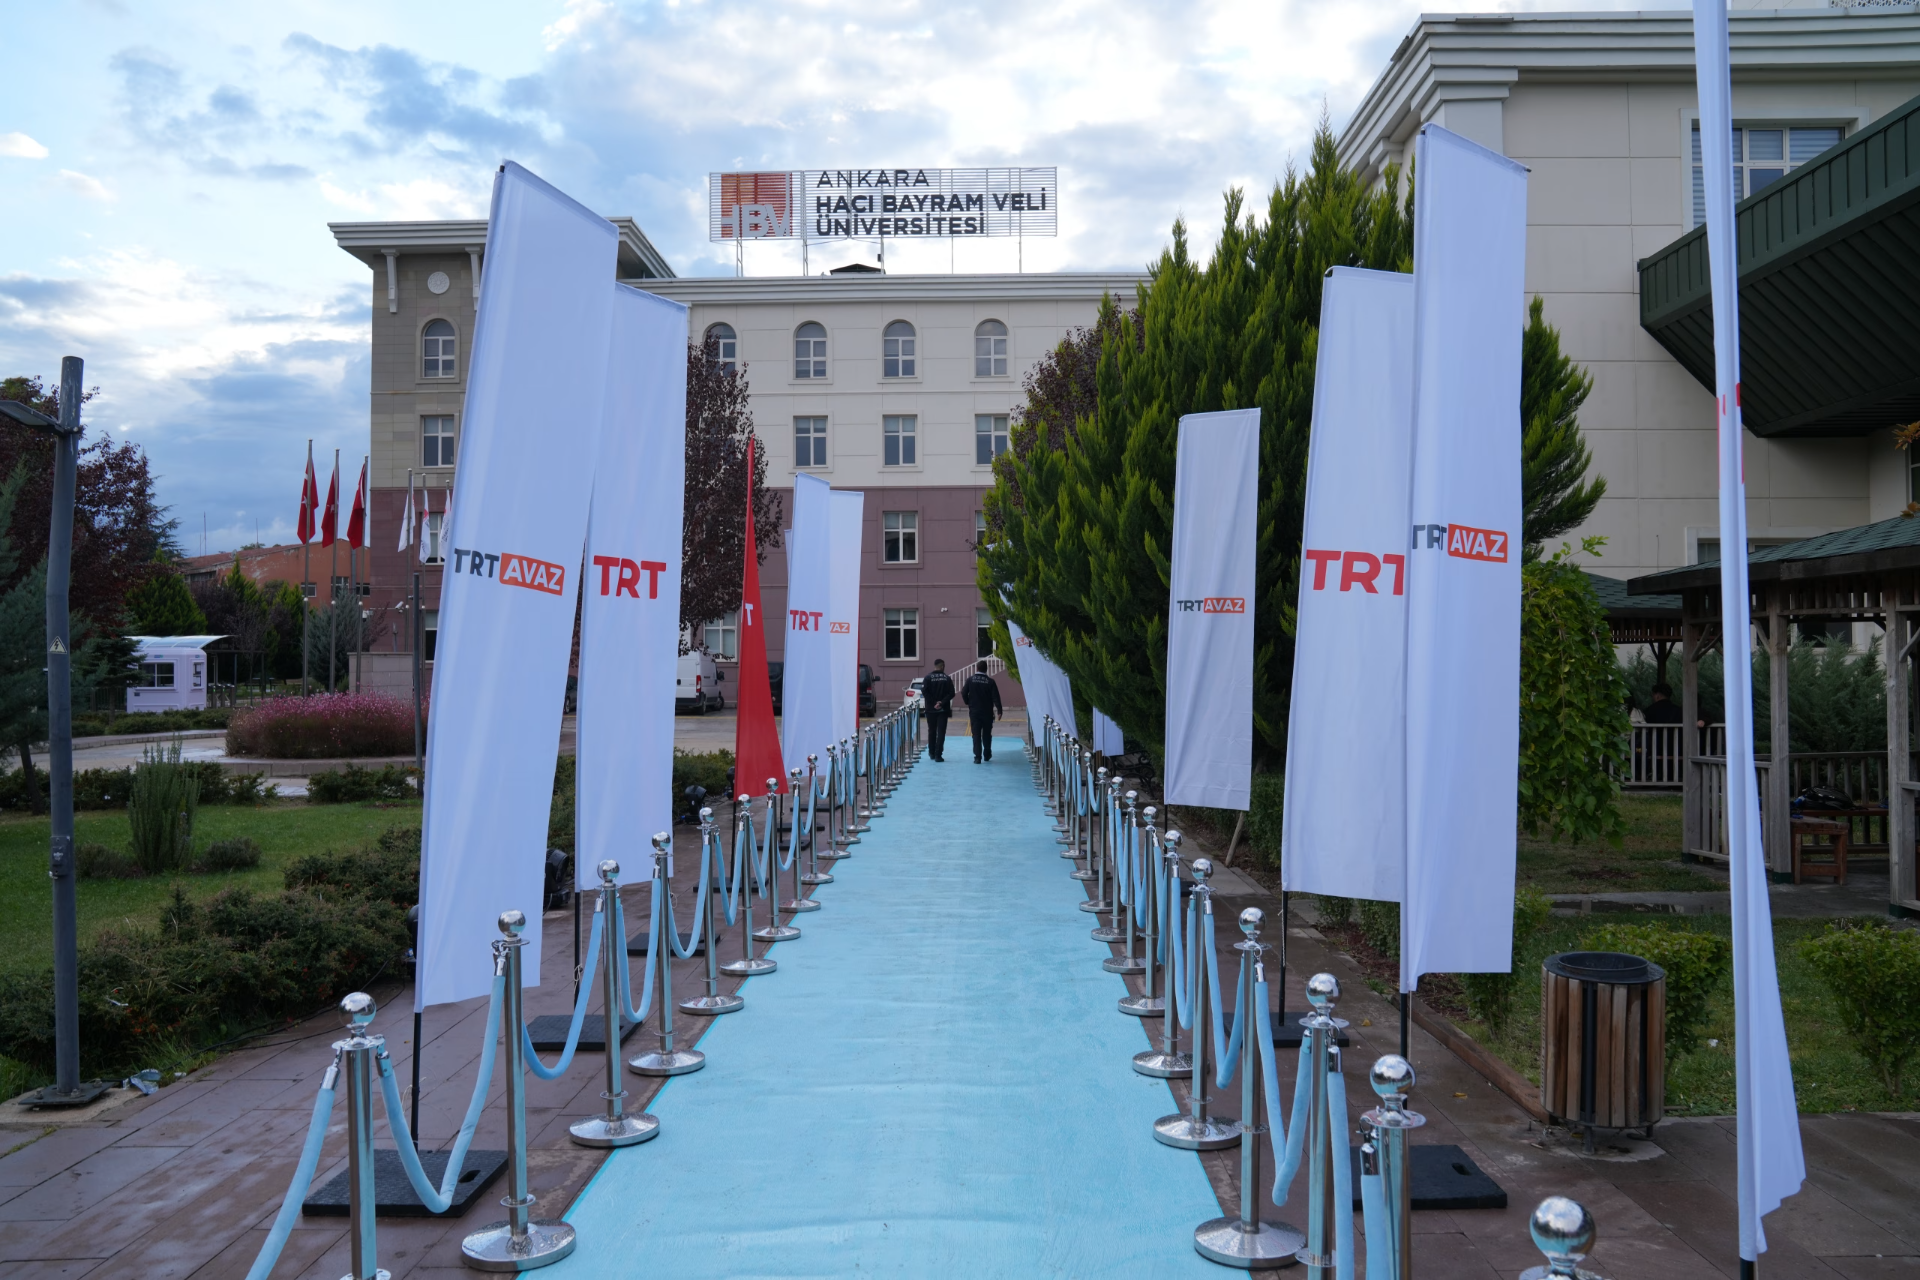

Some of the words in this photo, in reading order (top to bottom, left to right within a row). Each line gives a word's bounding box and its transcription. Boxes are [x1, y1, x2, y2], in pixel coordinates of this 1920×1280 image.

[816, 169, 930, 188] ANKARA
[816, 194, 873, 213] HACI
[883, 193, 984, 213] BAYRAM
[992, 187, 1046, 211] VELİ
[816, 212, 984, 236] ÜNİVERSİTESİ
[1450, 529, 1505, 558] AVAZ
[454, 548, 500, 578] TRT
[502, 558, 562, 591] AVAZ
[593, 555, 667, 600] TRT
[1306, 549, 1405, 596] TRT
[1177, 600, 1204, 612] TRT
[1204, 599, 1243, 612] AVAZ
[790, 609, 823, 631] TRT
